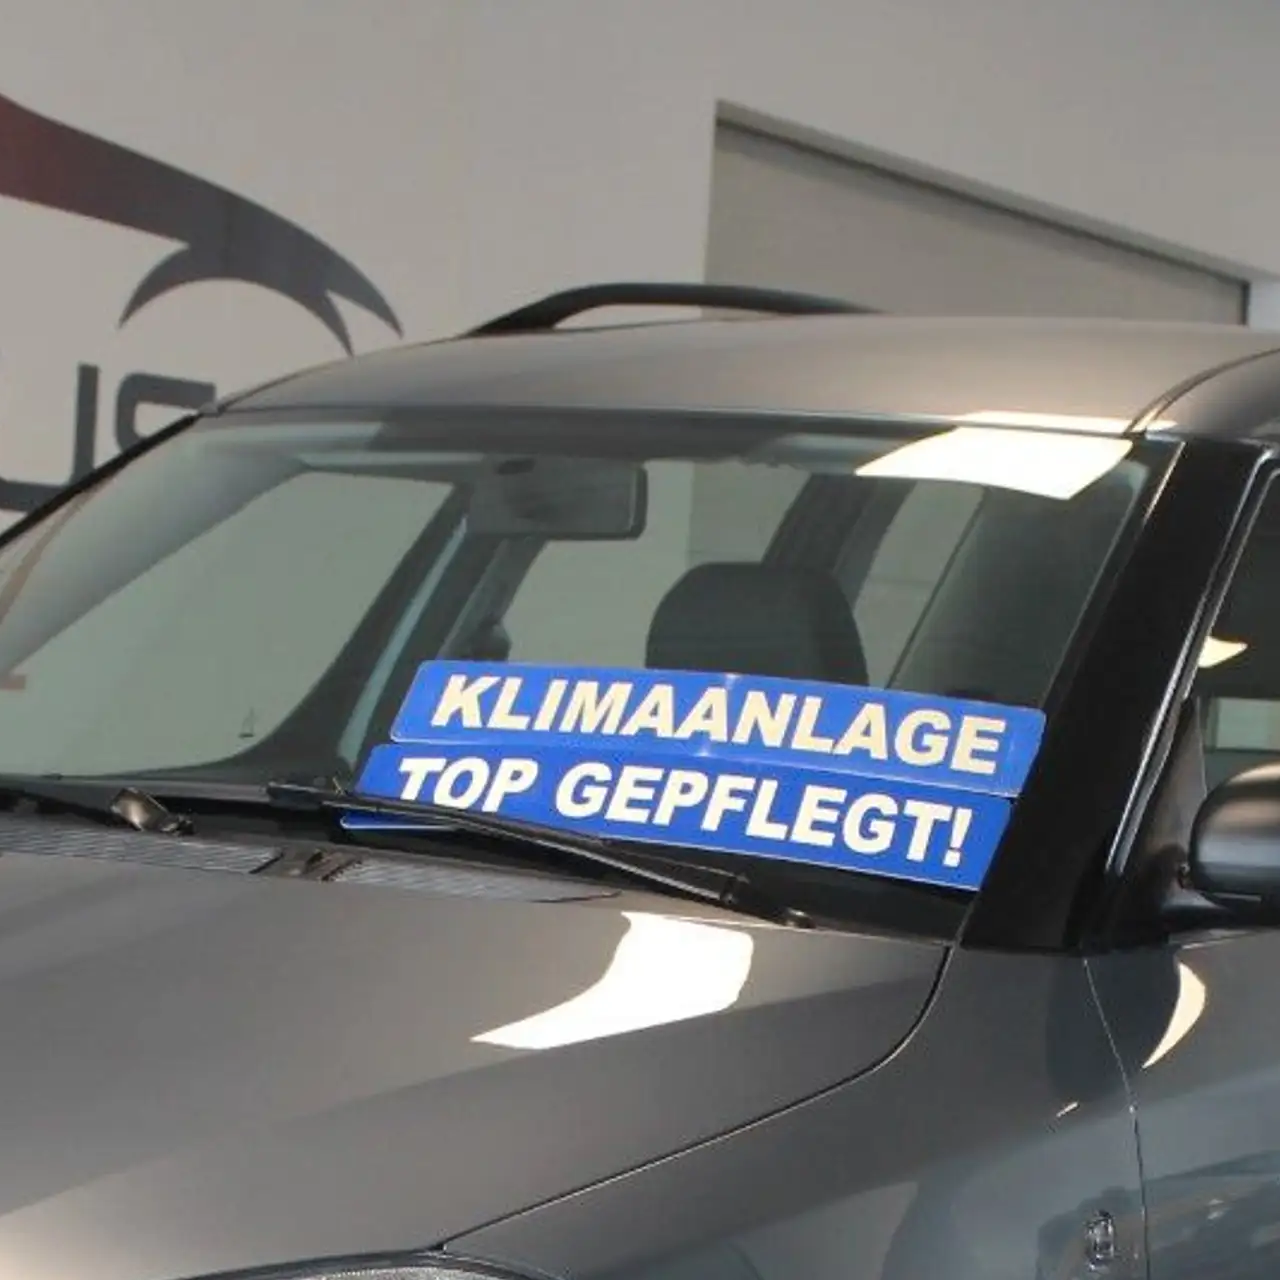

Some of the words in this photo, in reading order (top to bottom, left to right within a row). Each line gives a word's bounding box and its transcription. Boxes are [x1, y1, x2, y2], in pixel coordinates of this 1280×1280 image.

[430, 674, 1008, 775] KLIMAANLAGE
[397, 756, 539, 814] TOP
[555, 761, 974, 868] GEPFLEGT!
